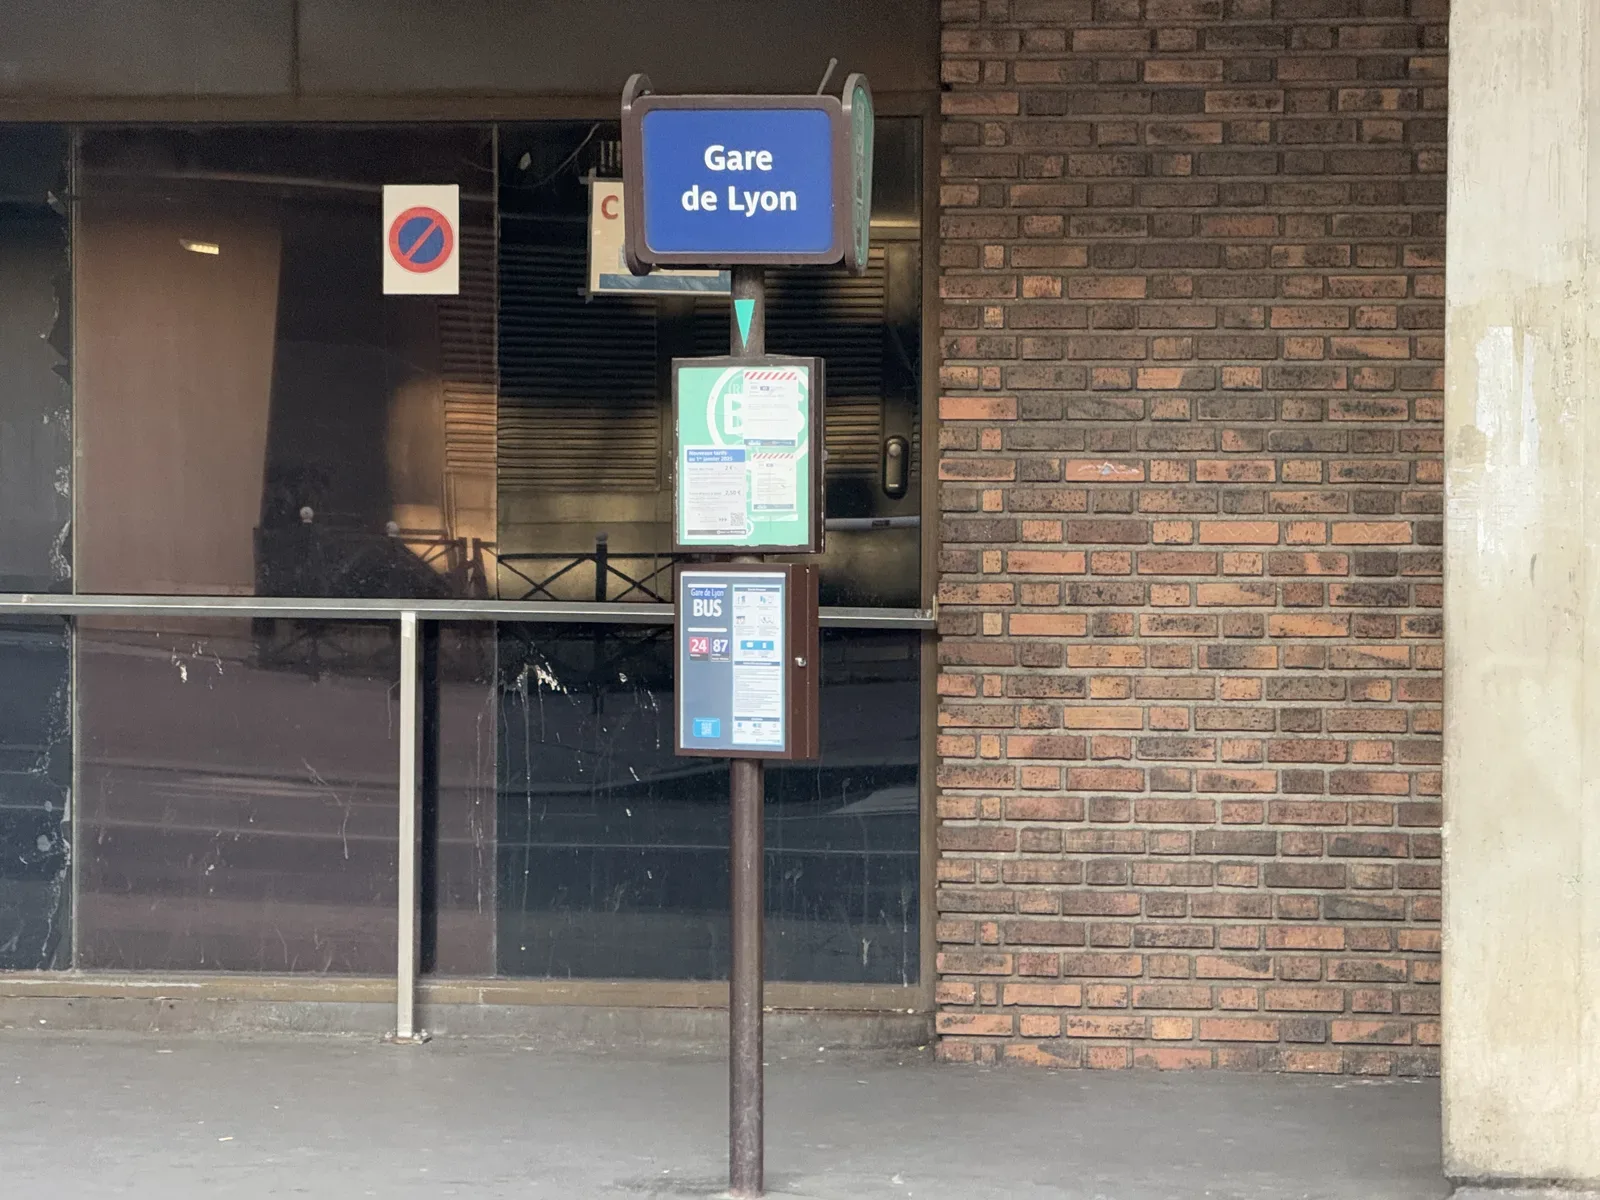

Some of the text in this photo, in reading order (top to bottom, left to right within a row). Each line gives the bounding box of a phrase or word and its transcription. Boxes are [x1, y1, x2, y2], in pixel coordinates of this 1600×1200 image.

[704, 145, 773, 171] Gare
[681, 185, 797, 218] de Lyon
[690, 588, 724, 598] Gare de Lyon
[693, 598, 722, 617] BUS
[691, 639, 729, 652] 24 87
